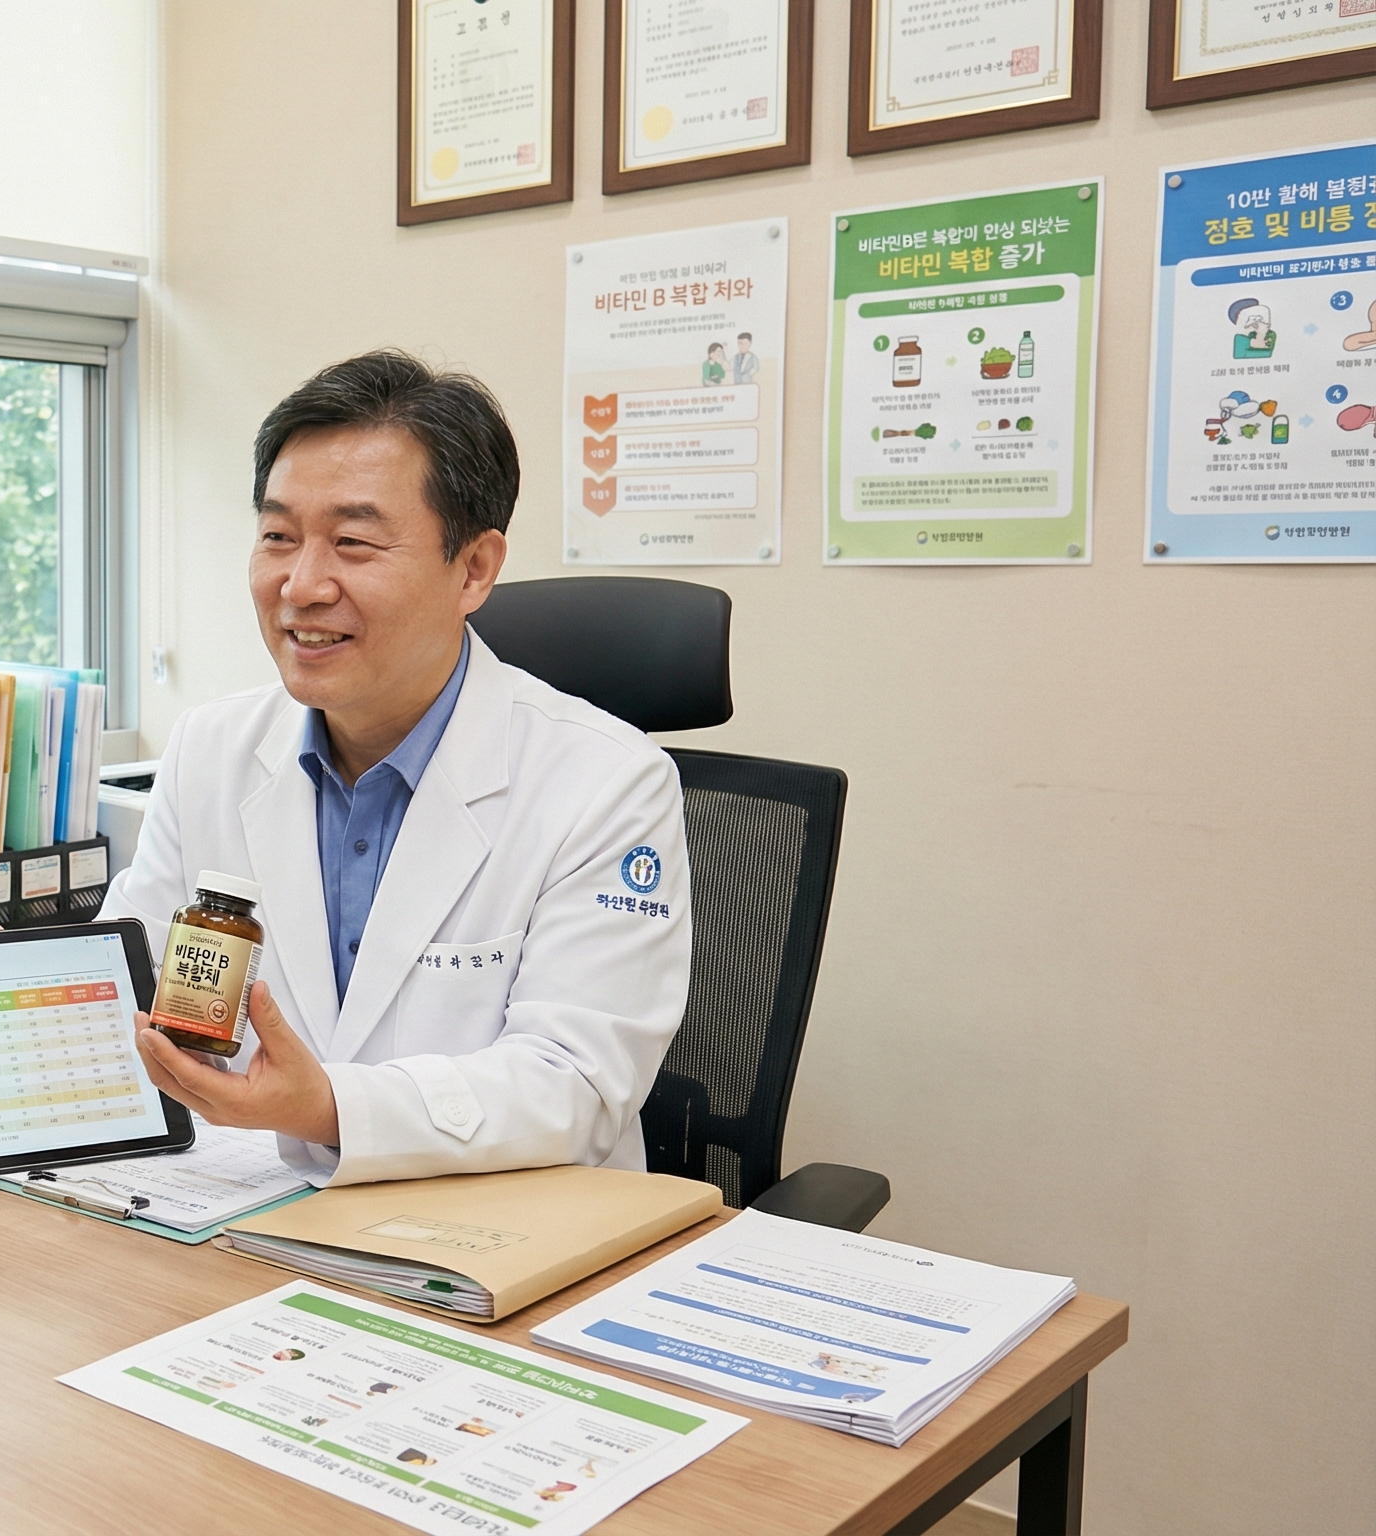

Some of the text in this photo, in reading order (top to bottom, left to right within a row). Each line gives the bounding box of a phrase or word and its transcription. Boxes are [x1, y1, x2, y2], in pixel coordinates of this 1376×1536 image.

[1265, 211, 1289, 239] 및
[878, 252, 941, 281] 비타민
[947, 246, 994, 274] 복합
[595, 289, 647, 314] 비타민
[652, 288, 666, 307] B
[219, 954, 230, 969] B
